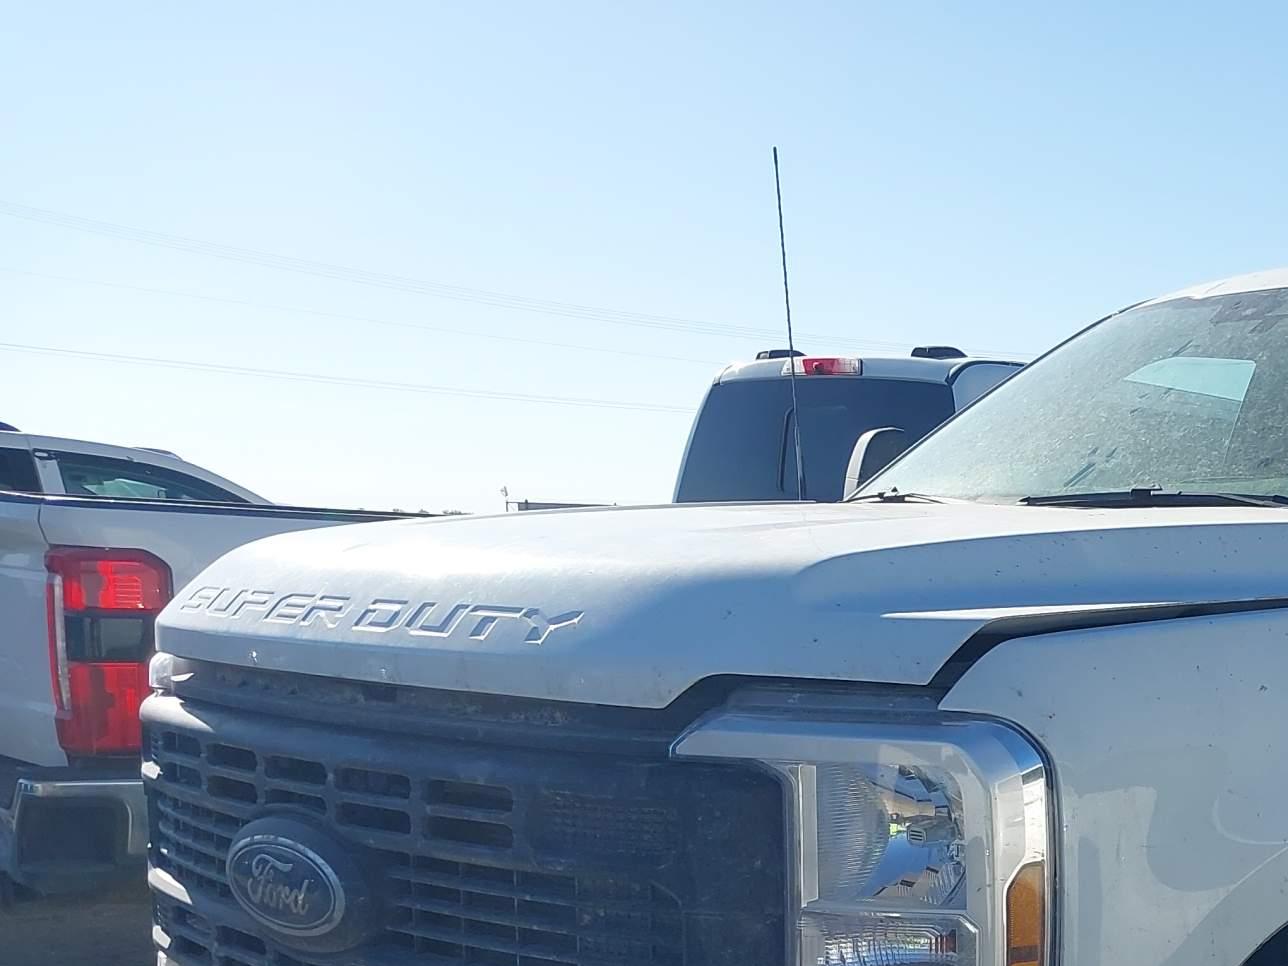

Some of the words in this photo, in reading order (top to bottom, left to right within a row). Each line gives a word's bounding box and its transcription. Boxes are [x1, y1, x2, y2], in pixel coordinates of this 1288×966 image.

[181, 585, 351, 628] SUPER
[351, 597, 585, 645] DUTY
[247, 853, 310, 915] Ford
